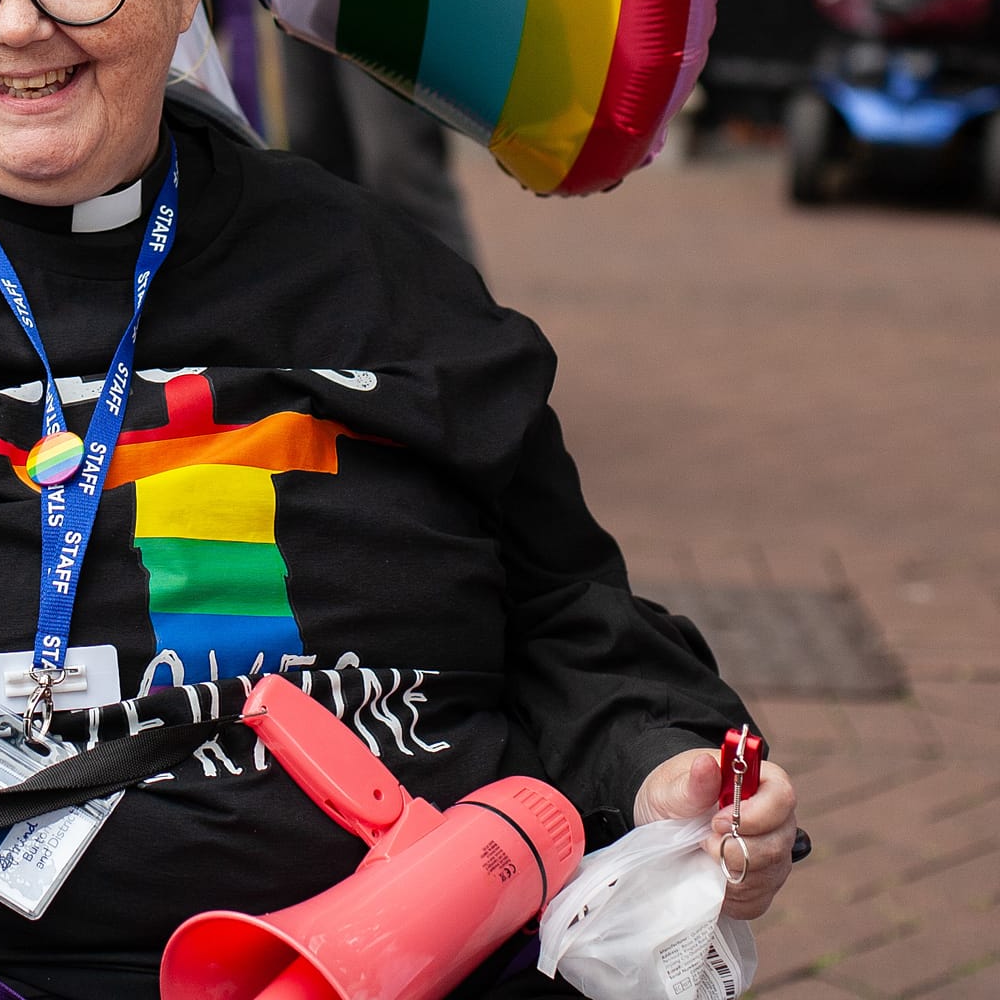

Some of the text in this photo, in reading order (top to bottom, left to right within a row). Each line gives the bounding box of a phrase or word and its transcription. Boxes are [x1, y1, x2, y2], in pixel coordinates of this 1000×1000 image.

[148, 204, 174, 253] STAFF
[1, 278, 34, 328] STAFF
[105, 362, 129, 416] STAFF
[78, 441, 107, 496] STAFF
[52, 530, 82, 595] STAFF
[41, 635, 61, 670] STA
[10, 822, 38, 856] mind
[22, 824, 53, 862] Burton
[35, 849, 53, 870] and
